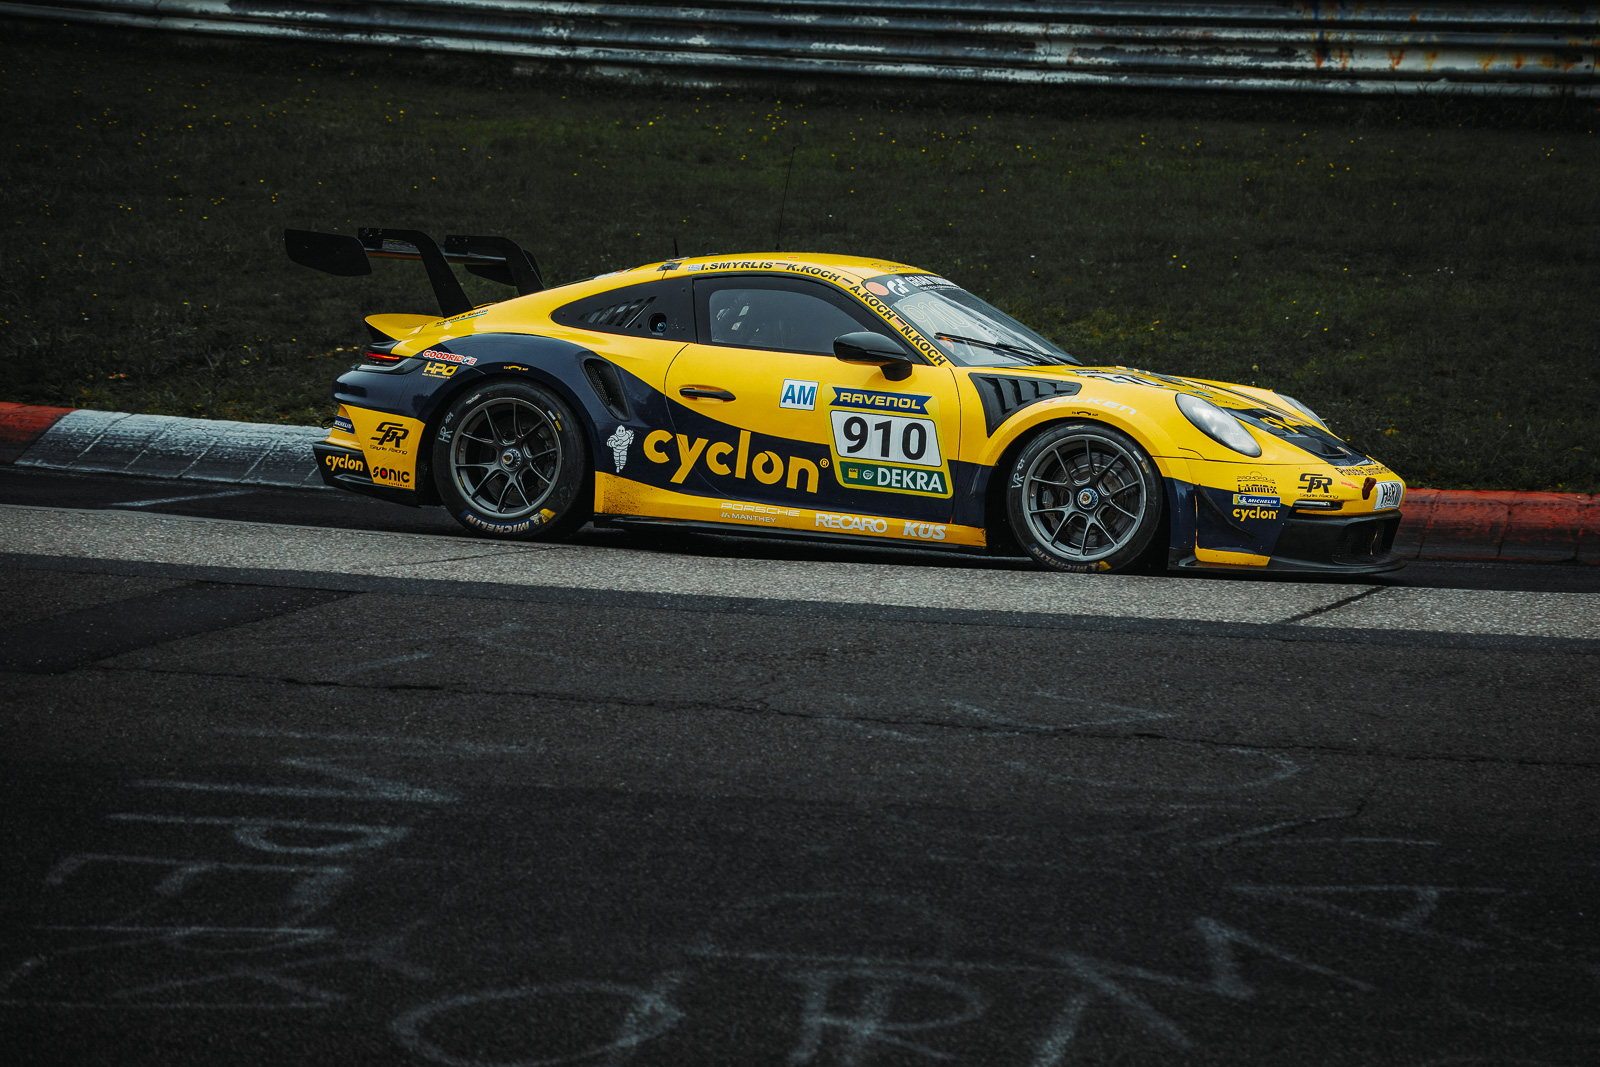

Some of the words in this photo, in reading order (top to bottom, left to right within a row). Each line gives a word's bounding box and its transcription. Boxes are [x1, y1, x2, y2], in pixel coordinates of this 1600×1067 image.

[786, 263, 840, 282] K.KOCH
[849, 284, 895, 321] A.KOCH
[900, 325, 946, 367] N.KOCH
[782, 385, 815, 406] AM
[839, 392, 921, 409] RAVENOL
[843, 416, 927, 460] 910
[325, 454, 364, 472] cyclon
[877, 467, 943, 492] DEKRA
[720, 503, 800, 518] PORSCHE
[731, 514, 777, 523] MANTHEY
[465, 513, 530, 534] MICHELIN
[815, 513, 888, 533] RECARO
[902, 521, 946, 540] KÜS
